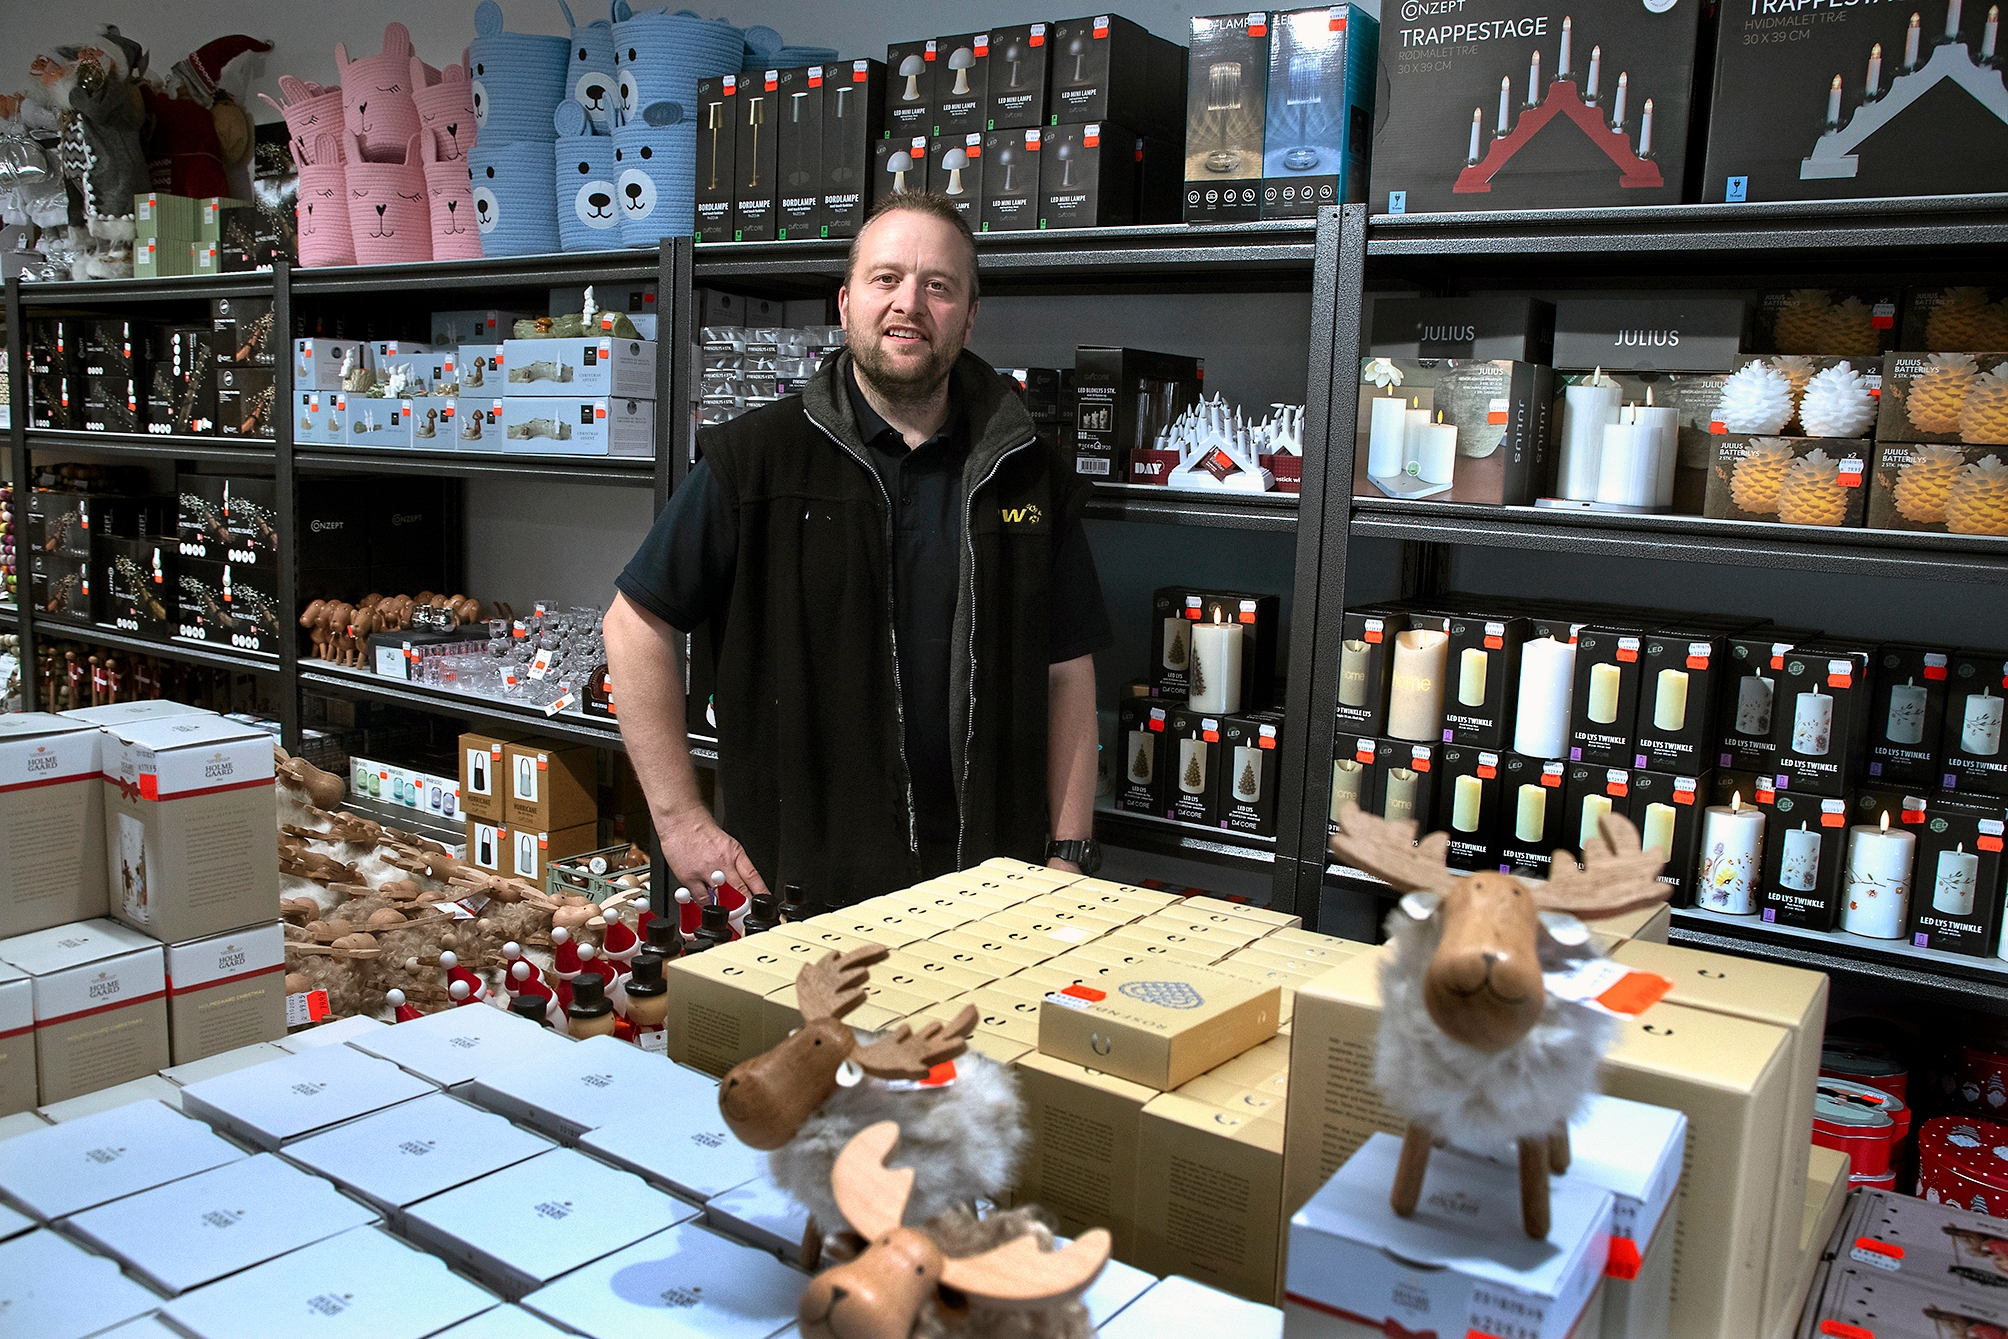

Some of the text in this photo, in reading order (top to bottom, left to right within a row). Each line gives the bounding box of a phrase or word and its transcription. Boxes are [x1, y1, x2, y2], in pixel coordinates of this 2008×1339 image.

[1744, 11, 1847, 30] HVIDMALET TRÆ
[1400, 16, 1548, 48] TRAPPESTAGE
[1743, 29, 1810, 46] 30 X 39 CM
[1399, 45, 1478, 60] RØDMALET TRÆ
[826, 68, 837, 78] LED
[1398, 61, 1451, 74] 30 X 39 CM
[739, 79, 750, 88] LED
[781, 74, 792, 83] LED
[699, 84, 709, 93] LED
[739, 200, 770, 209] BORDLAMPE
[783, 197, 816, 208] BORDLAMPE
[825, 194, 858, 204] BORDLAMPE
[699, 203, 728, 211] BORDLAMPE
[1421, 326, 1475, 341] JULIUS
[1615, 330, 1680, 347] JULIUS
[1894, 366, 1940, 374] BATTERILYS
[1514, 400, 1525, 463] JULIUS
[1719, 449, 1760, 457] BATTERILYS
[1883, 448, 1909, 456] JULIUS
[1882, 455, 1927, 463] BATTERILYS
[1135, 461, 1162, 475] DAY
[1580, 640, 1596, 648] LED
[1647, 645, 1663, 654] LED
[1787, 664, 1805, 673] LED
[1362, 710, 1372, 718] LYS
[1447, 714, 1457, 722] LED
[1468, 717, 1493, 727] TWINKLE
[1598, 734, 1626, 744] TWINKLE
[1725, 738, 1736, 746] LED
[1640, 739, 1693, 752] LED LYS TWINKLE
[1875, 747, 1930, 760] LED LYS TWINKLE
[28, 756, 57, 766] HOLME
[1780, 758, 1837, 772] LED LYS TWINKLE
[1949, 758, 2008, 772] LED LYS TWINKLE
[28, 763, 58, 772] GAARD
[205, 762, 233, 773] HOLME
[205, 768, 234, 778] GAARD
[1635, 779, 1651, 787] LED
[467, 795, 491, 806] HURRICANE
[1777, 800, 1793, 808] LED
[513, 803, 538, 814] HURRICANE
[1930, 822, 1947, 830] LED
[1451, 841, 1487, 853] LYS TWINKLE
[1515, 851, 1525, 859] LYS
[1526, 852, 1552, 863] TWINKLE
[1768, 892, 1825, 909] LED LYS TWINKLE
[1920, 916, 1982, 934] LED LYS TWINKLE
[218, 958, 246, 970] GAARD
[219, 953, 245, 964] HOLME
[89, 986, 120, 998] GAARD
[90, 980, 119, 993] HOLME
